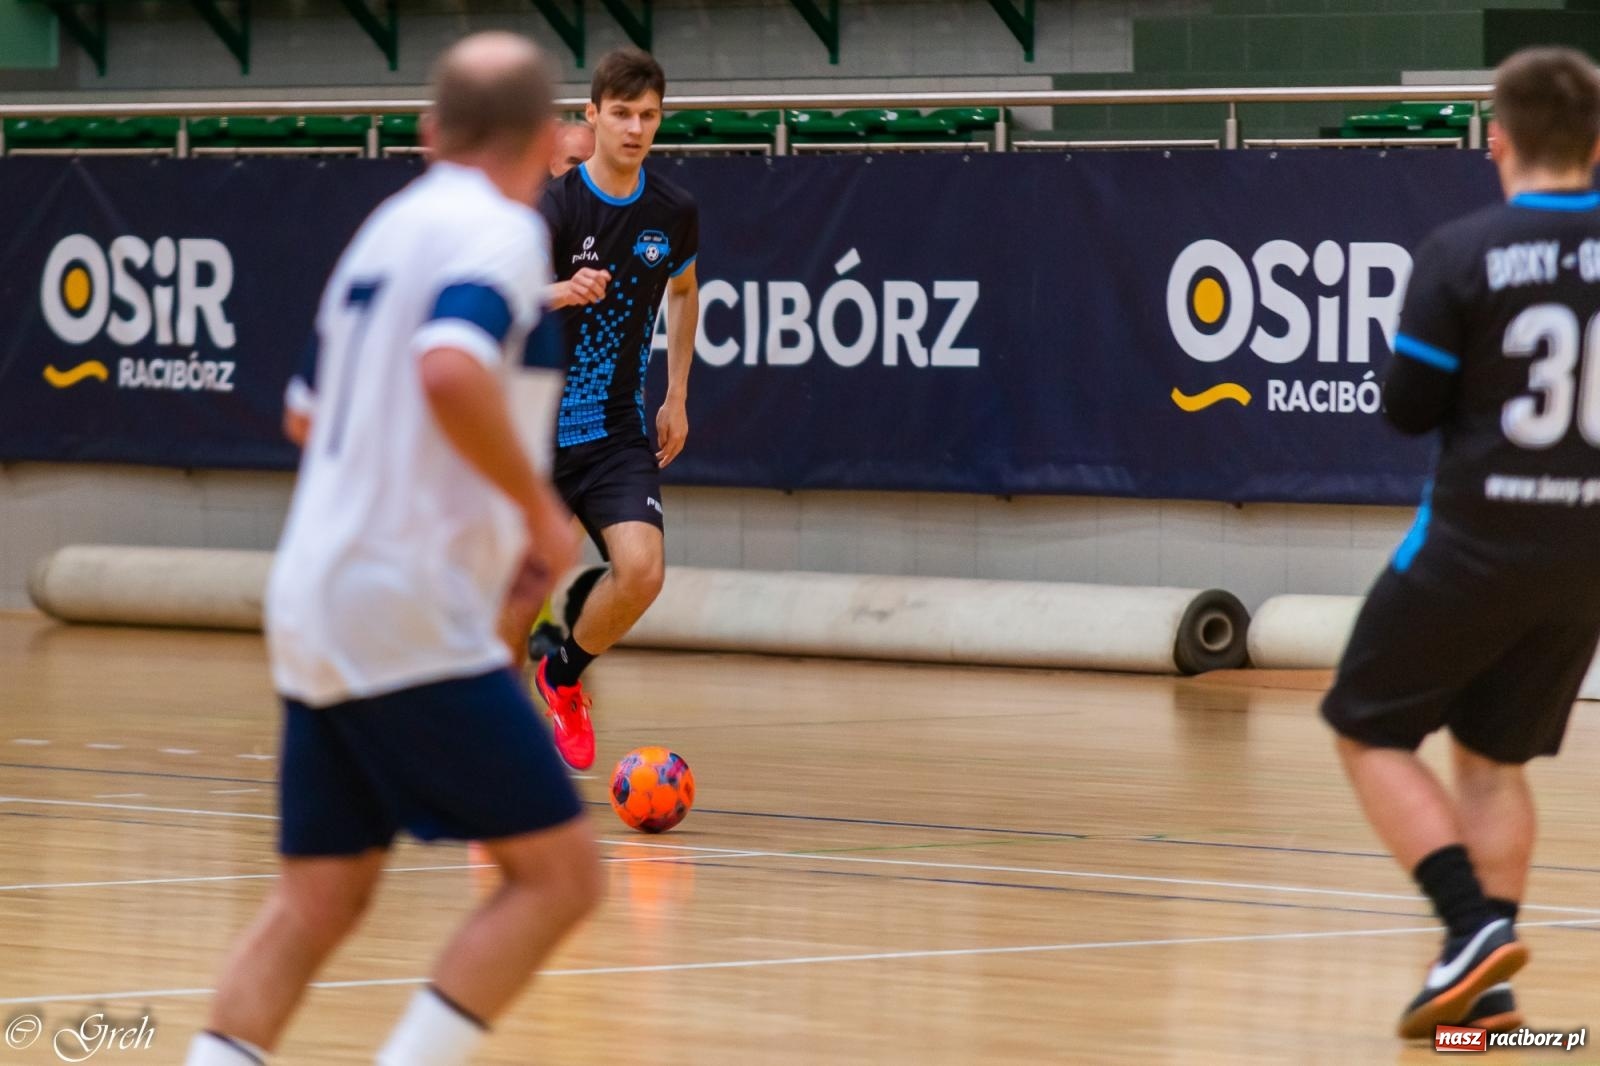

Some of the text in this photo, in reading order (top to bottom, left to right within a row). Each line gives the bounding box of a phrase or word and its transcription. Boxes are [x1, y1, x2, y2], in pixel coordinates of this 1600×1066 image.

[41, 234, 236, 349] OSiR
[118, 352, 236, 391] RACIBÓRZ
[1267, 370, 1386, 414] RACIBÓ
